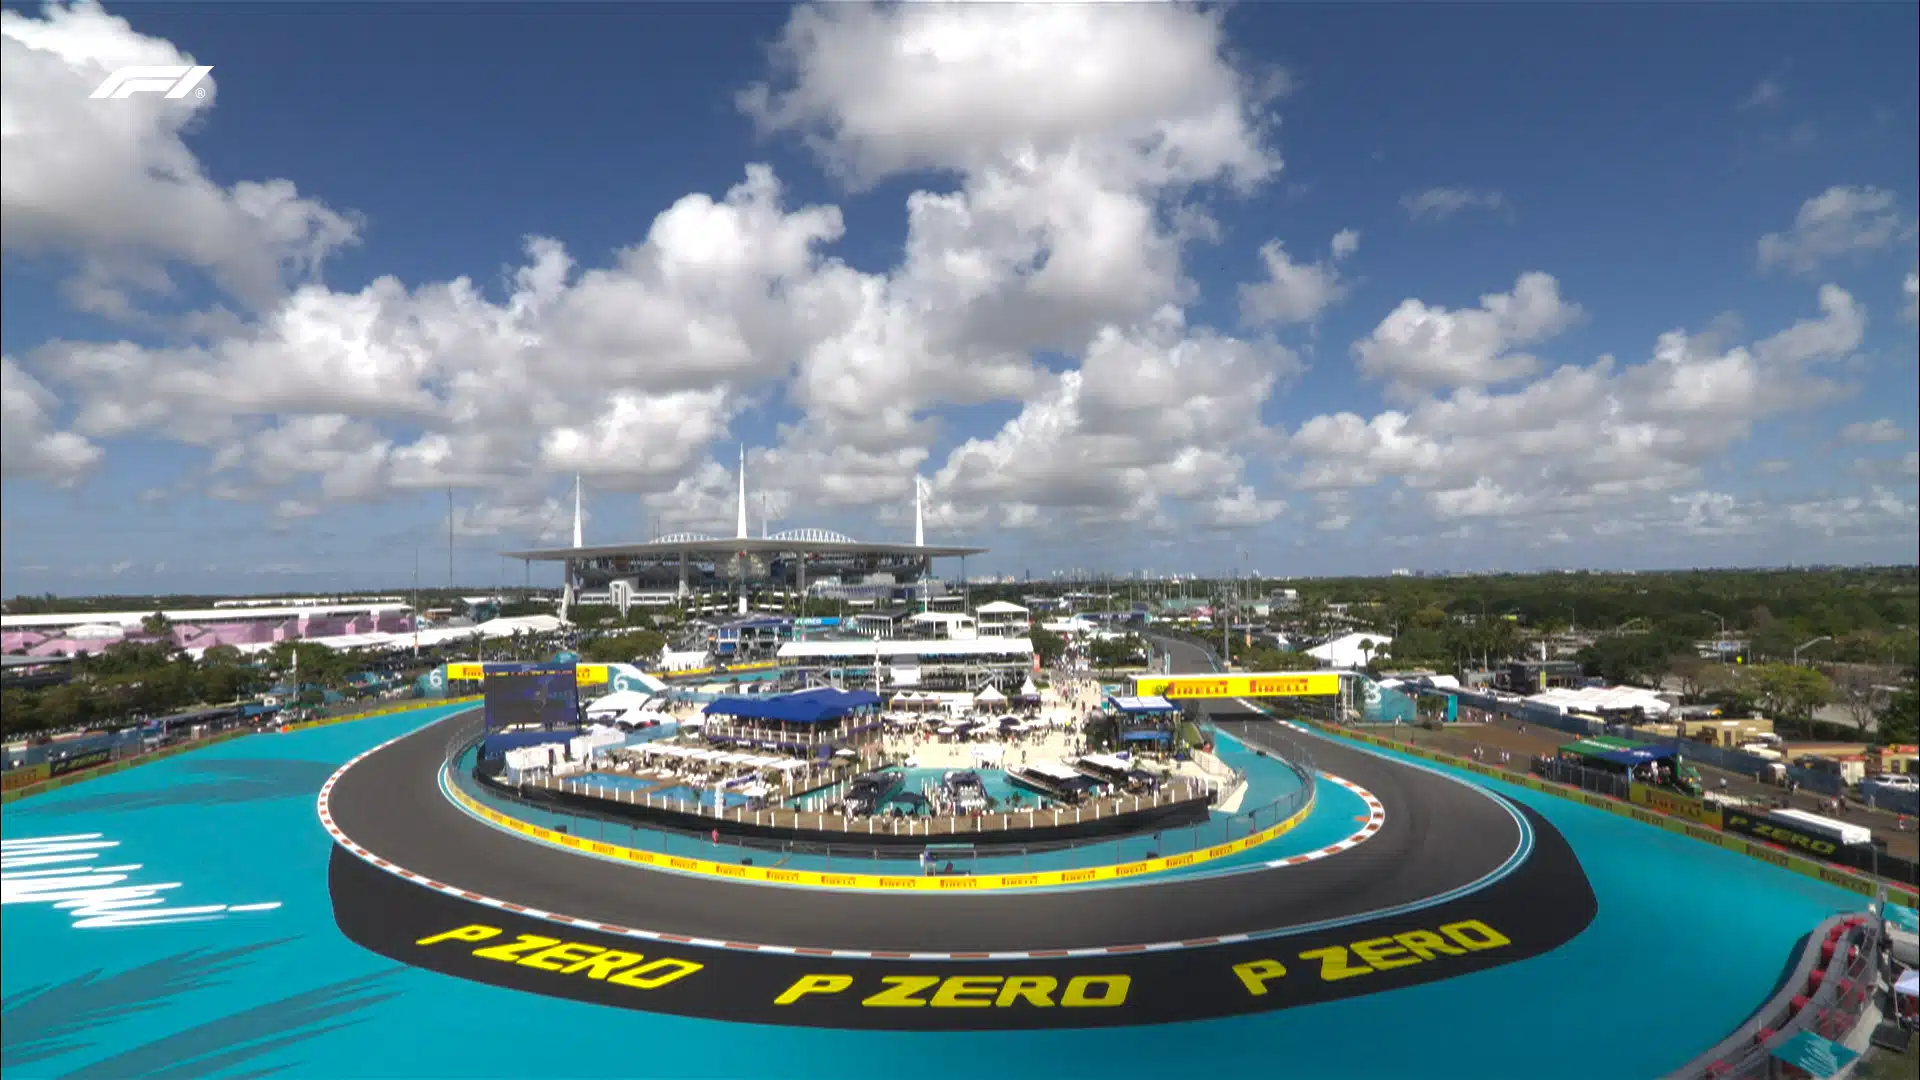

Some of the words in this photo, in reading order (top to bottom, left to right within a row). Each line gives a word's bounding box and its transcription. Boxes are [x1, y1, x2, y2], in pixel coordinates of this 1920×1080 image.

[429, 668, 442, 687] 6
[613, 672, 628, 692] 6
[1168, 680, 1228, 696] PIRELLI
[1249, 678, 1309, 694] PIRELLI
[1061, 869, 1096, 882] PIRELLI
[1115, 863, 1147, 876] PIRELLI
[821, 875, 856, 886] PIRELLI
[880, 877, 916, 888] PIRELLI
[940, 878, 977, 889] PIRELLI
[1001, 876, 1038, 887] PIRELLI
[415, 924, 503, 945] P
[472, 934, 704, 990] ZERO
[1231, 958, 1287, 996] P
[1299, 919, 1511, 981] ZERO
[773, 974, 853, 1005] P
[862, 974, 1132, 1007] ZERO
